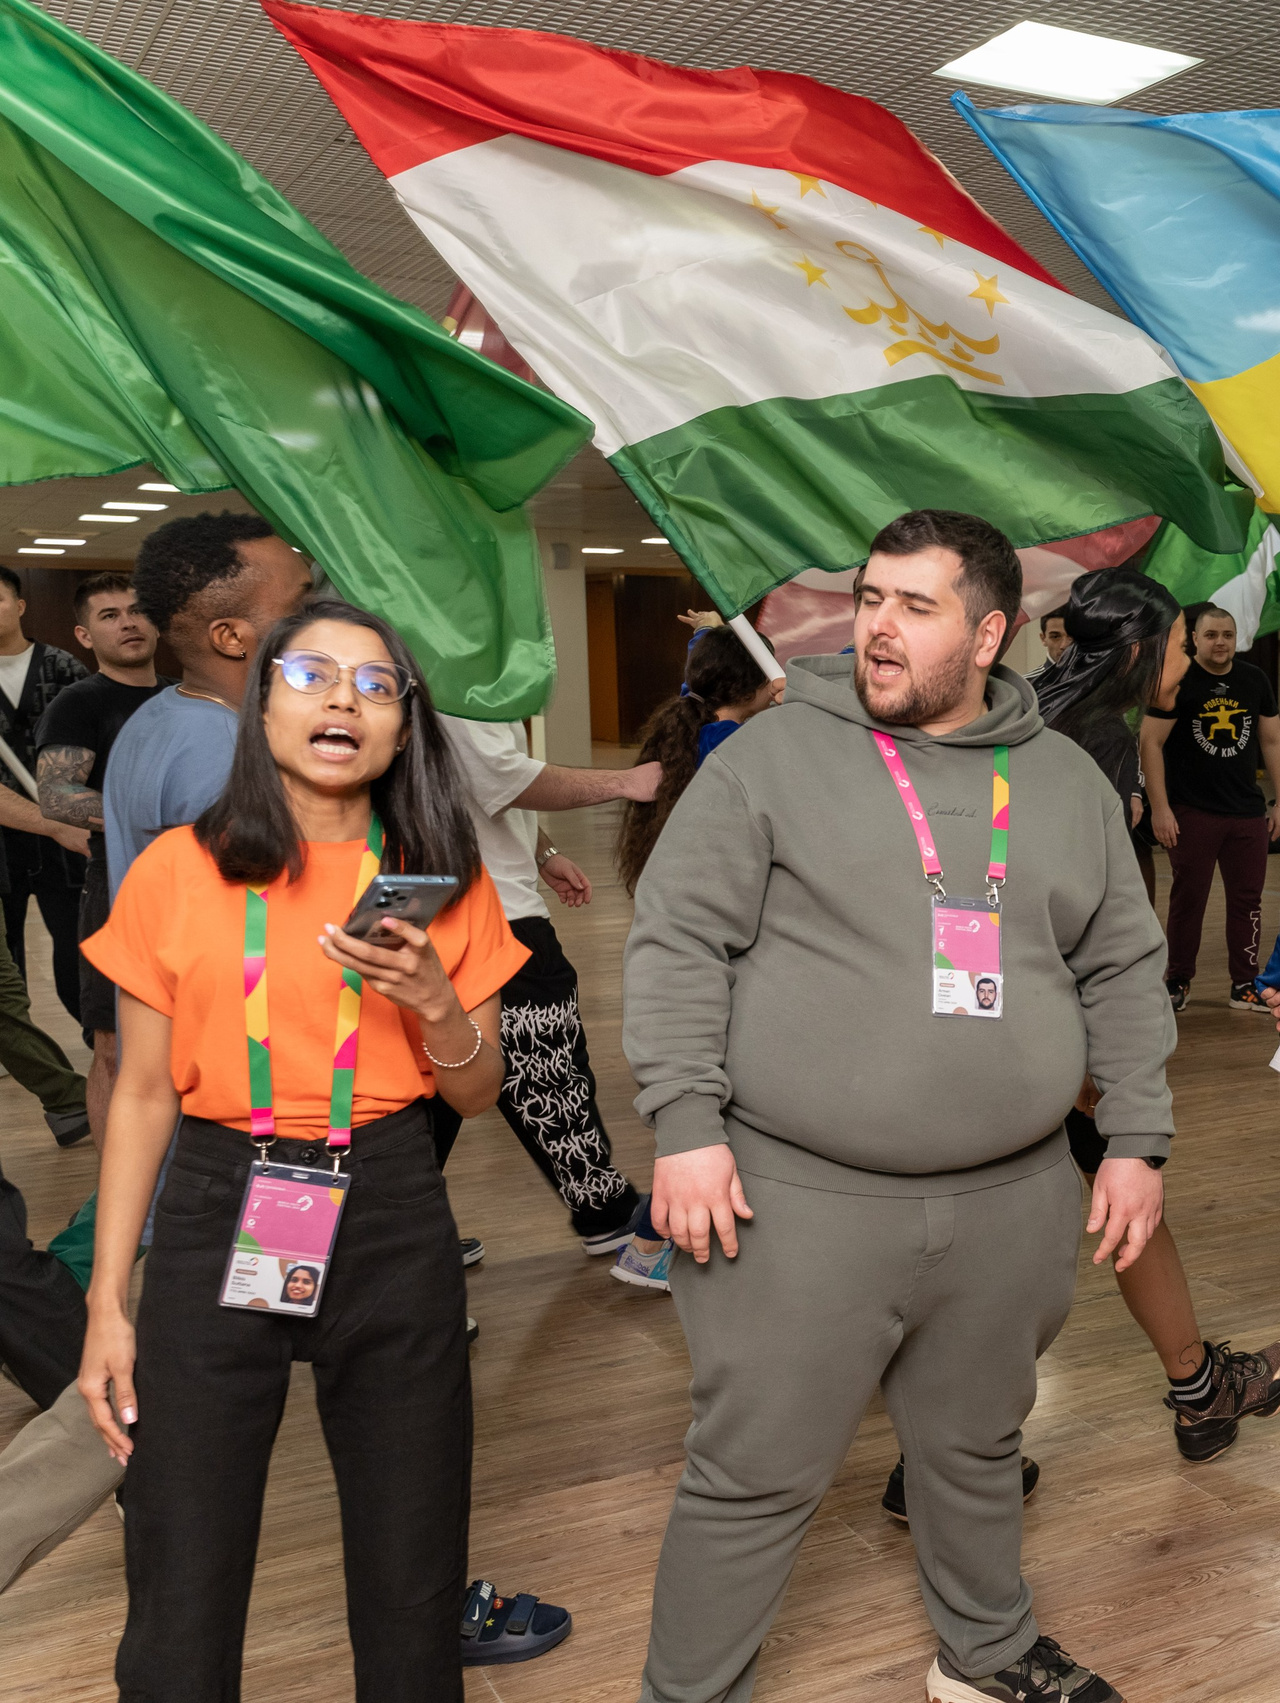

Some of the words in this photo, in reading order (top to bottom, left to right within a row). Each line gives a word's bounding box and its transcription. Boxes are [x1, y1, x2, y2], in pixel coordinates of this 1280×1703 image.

[1203, 698, 1239, 711] РОВЕНЬКИ
[1192, 719, 1218, 755] ОТКИСНЕМ
[1221, 746, 1238, 757] КАК
[1237, 715, 1252, 750] СЛЕДУЕТ
[480, 1581, 493, 1600] NIKE
